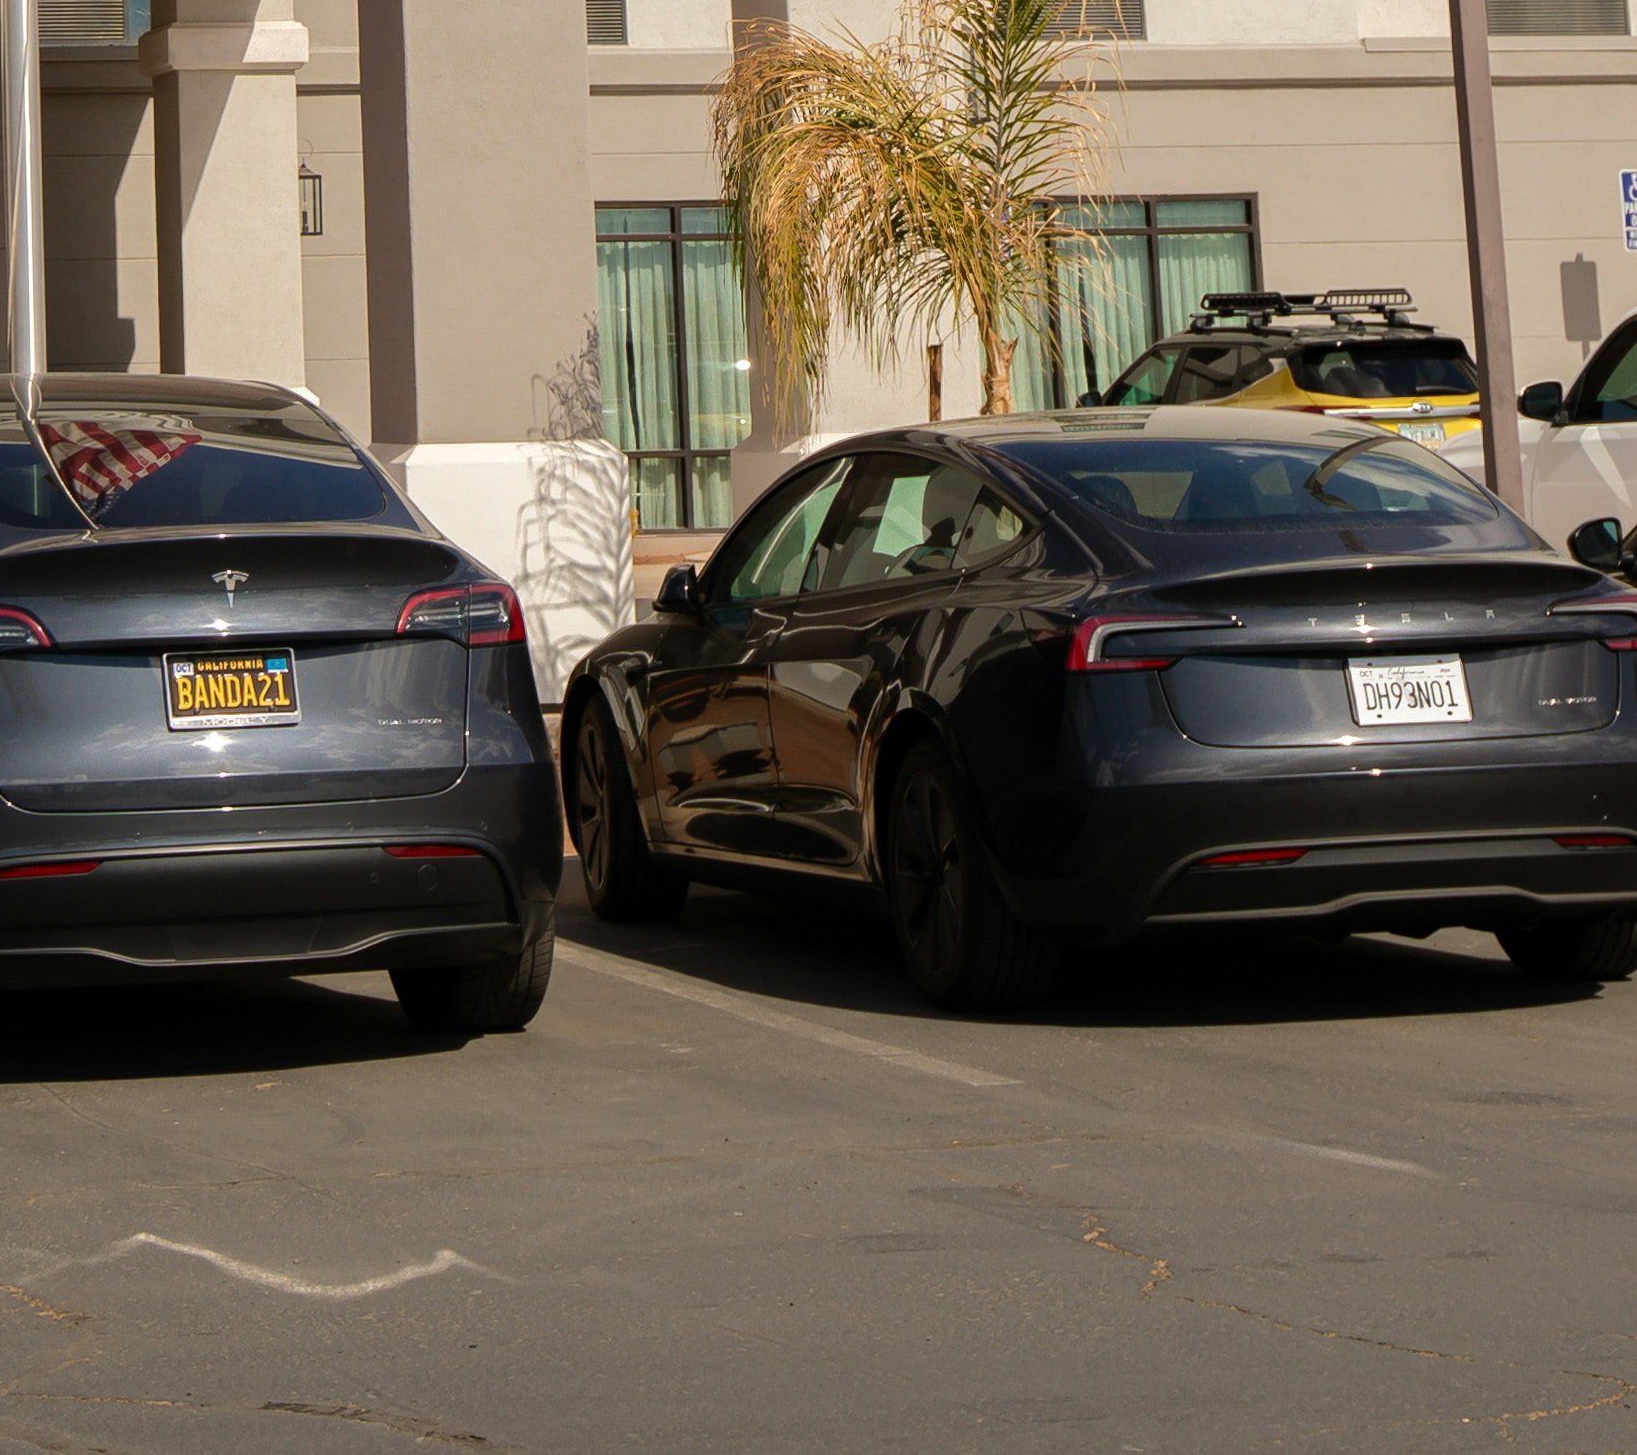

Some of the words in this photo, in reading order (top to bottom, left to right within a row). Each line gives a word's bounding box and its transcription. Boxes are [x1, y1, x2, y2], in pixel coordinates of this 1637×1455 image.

[1308, 609, 1495, 627] TESLA
[176, 664, 192, 674] OCT
[197, 659, 264, 671] CALIFORNIA
[177, 673, 290, 710] BANDA21
[1363, 680, 1458, 710] DH93N01
